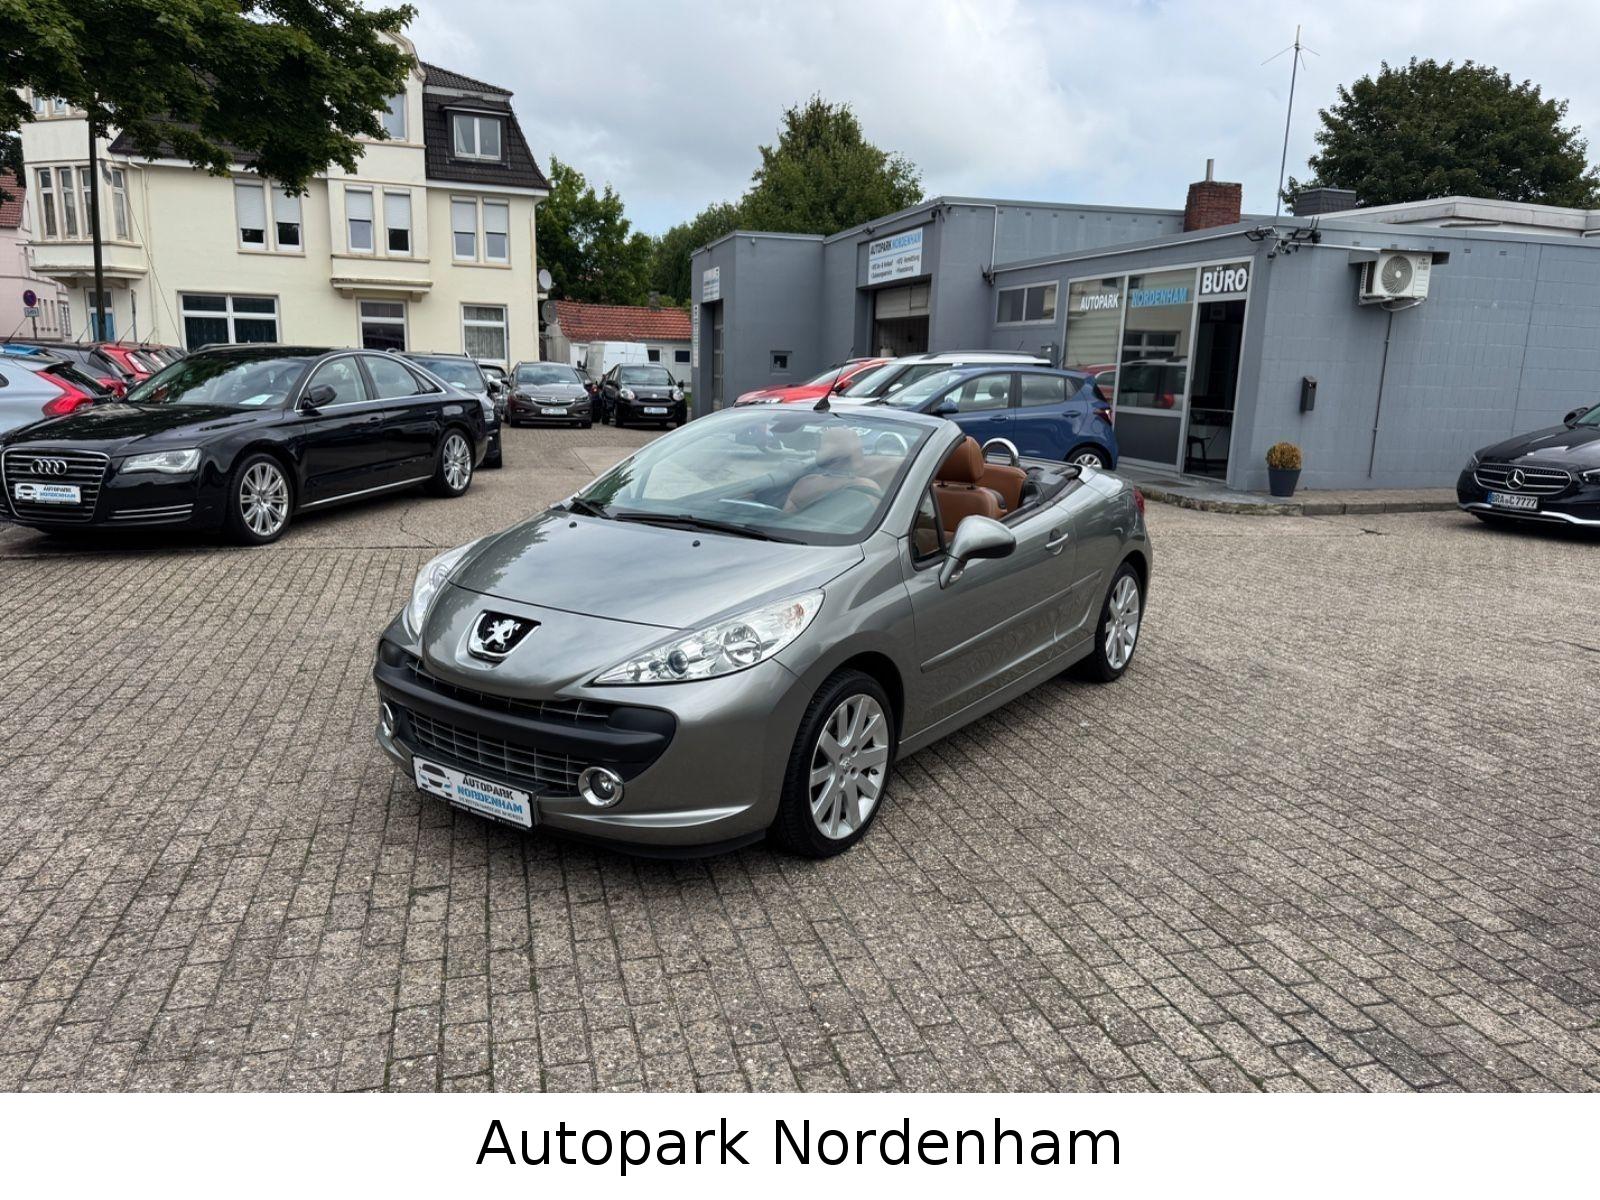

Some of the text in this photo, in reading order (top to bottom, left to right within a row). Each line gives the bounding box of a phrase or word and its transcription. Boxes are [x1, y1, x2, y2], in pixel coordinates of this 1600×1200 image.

[1202, 266, 1248, 294] BÜRO
[1079, 287, 1189, 312] AUTOPARK NORDENHAM
[456, 784, 523, 815] NORDENHAM
[462, 775, 514, 801] AUTOPARK
